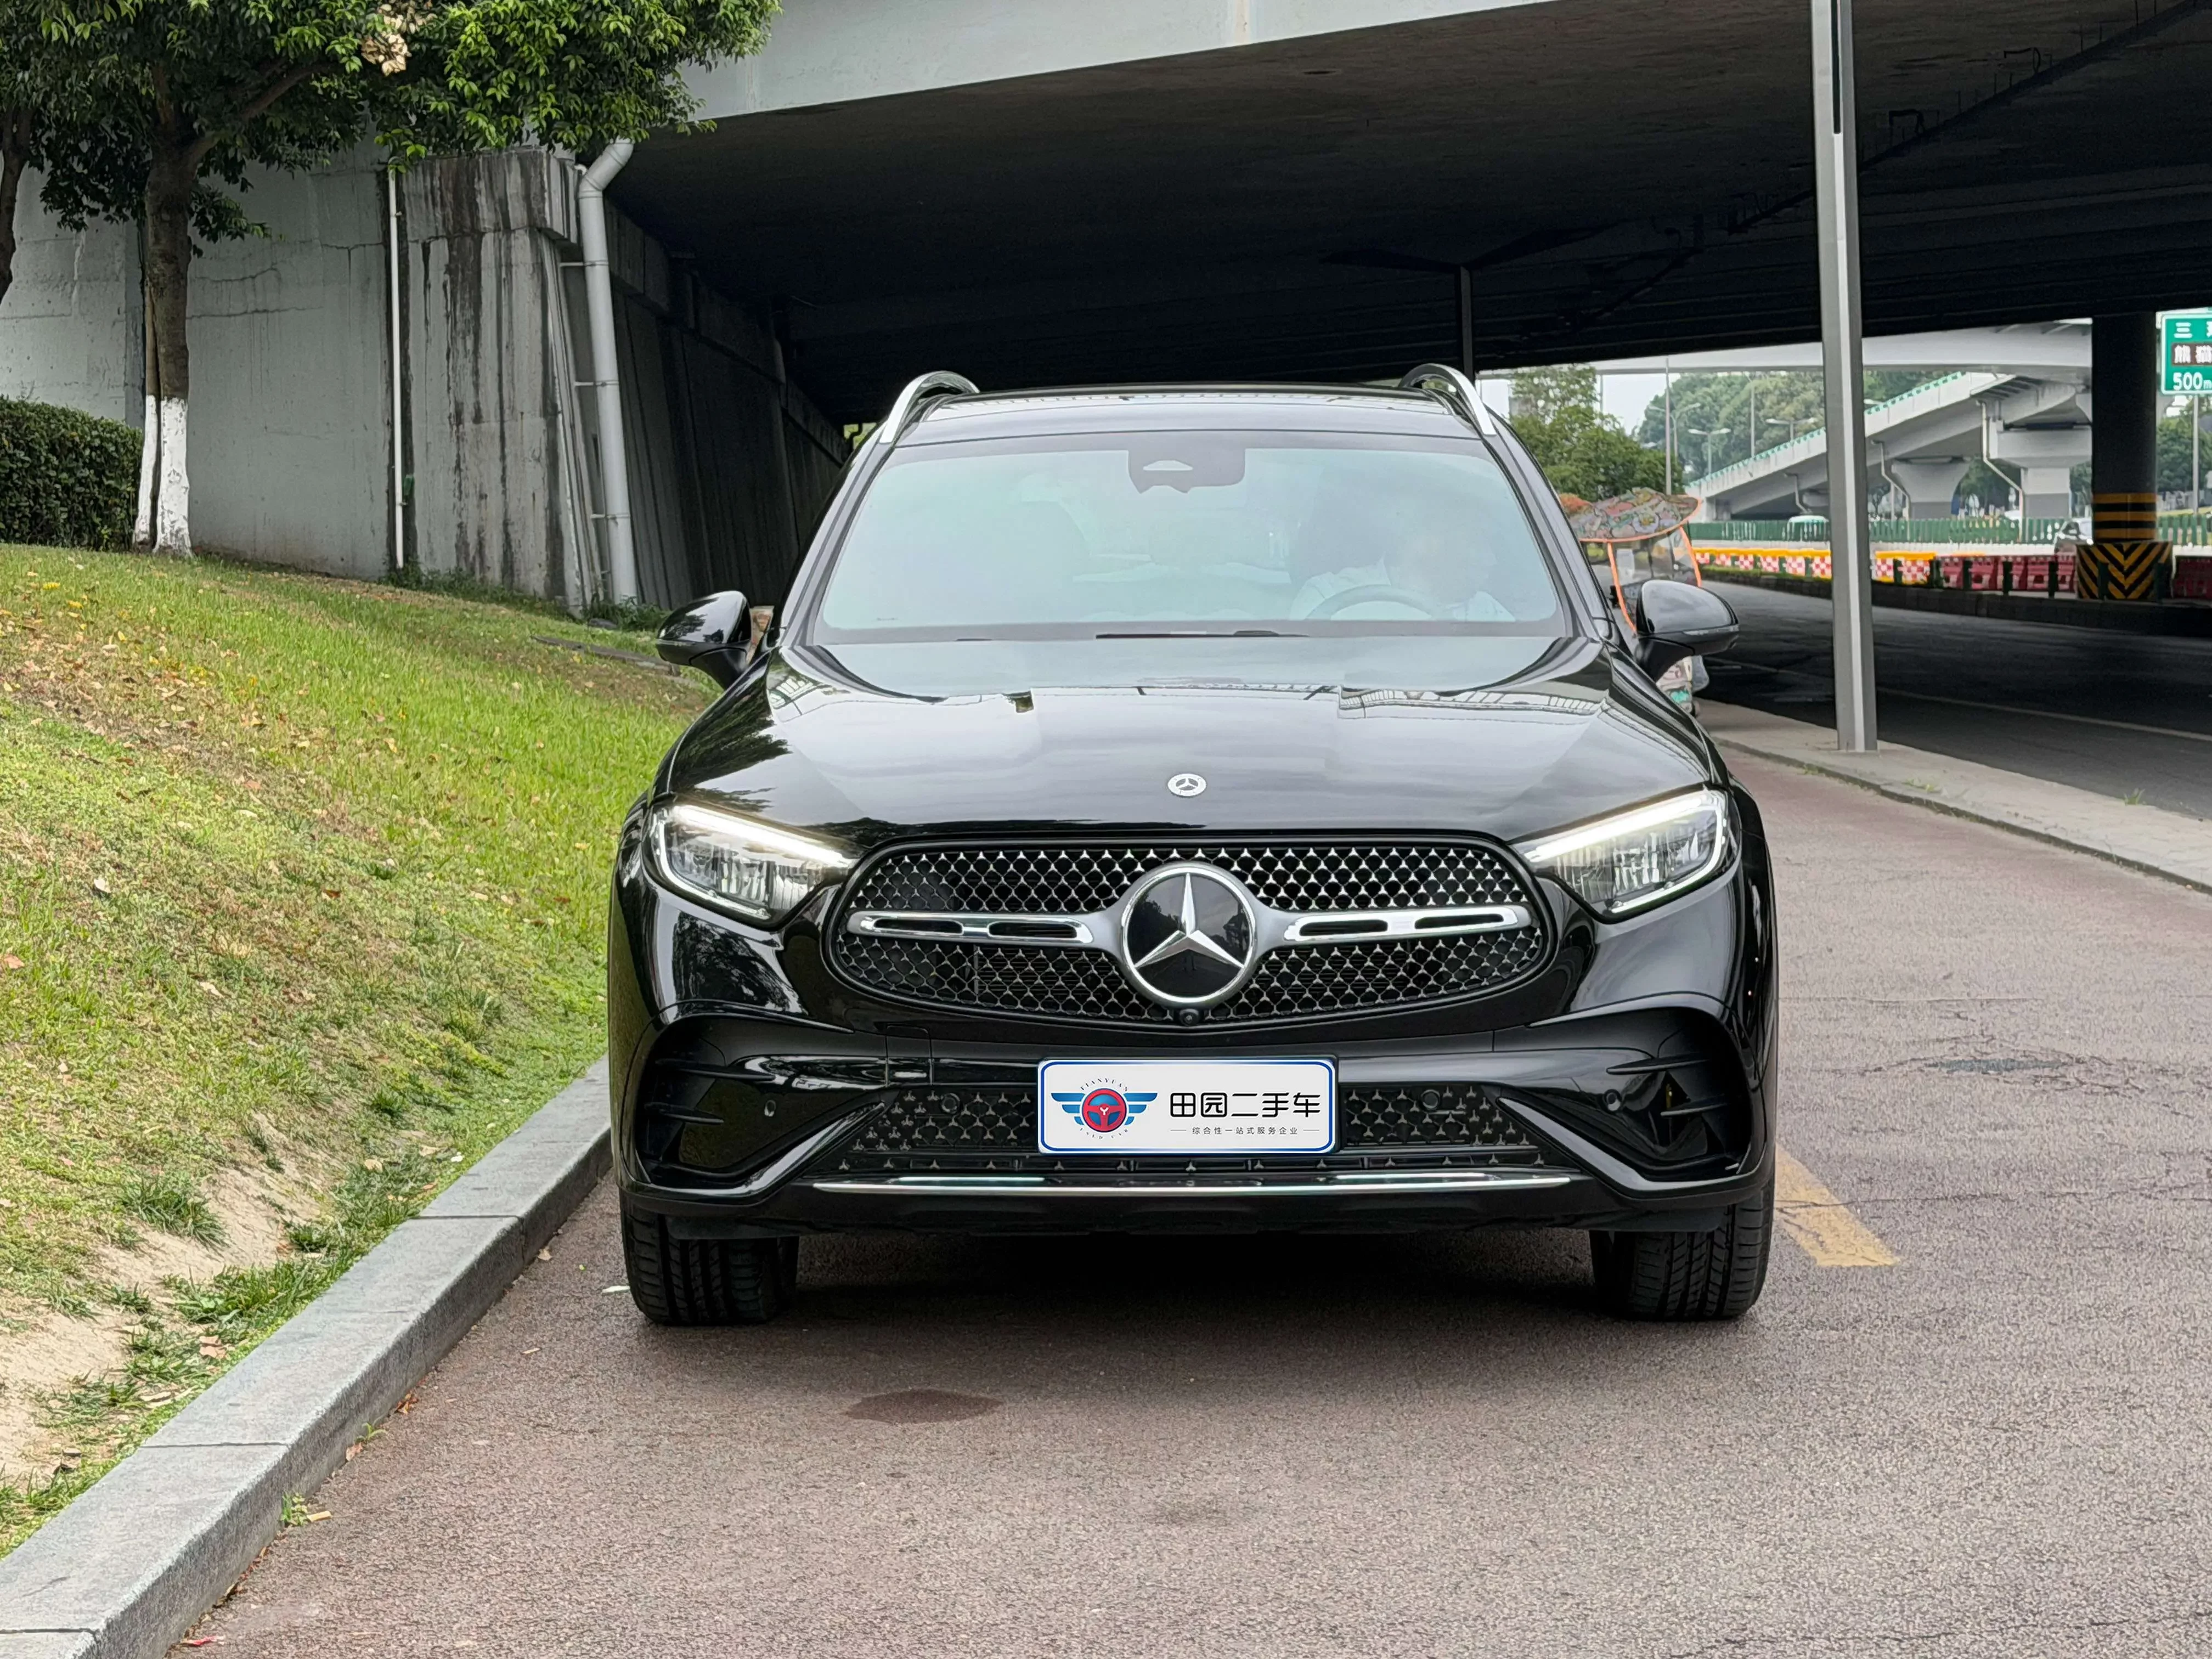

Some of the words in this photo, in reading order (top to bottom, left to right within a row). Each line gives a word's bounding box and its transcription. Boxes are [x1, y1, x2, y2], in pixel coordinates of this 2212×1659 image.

[2173, 372, 2212, 391] 500m
[1170, 1092, 1321, 1118] 田园二手车
